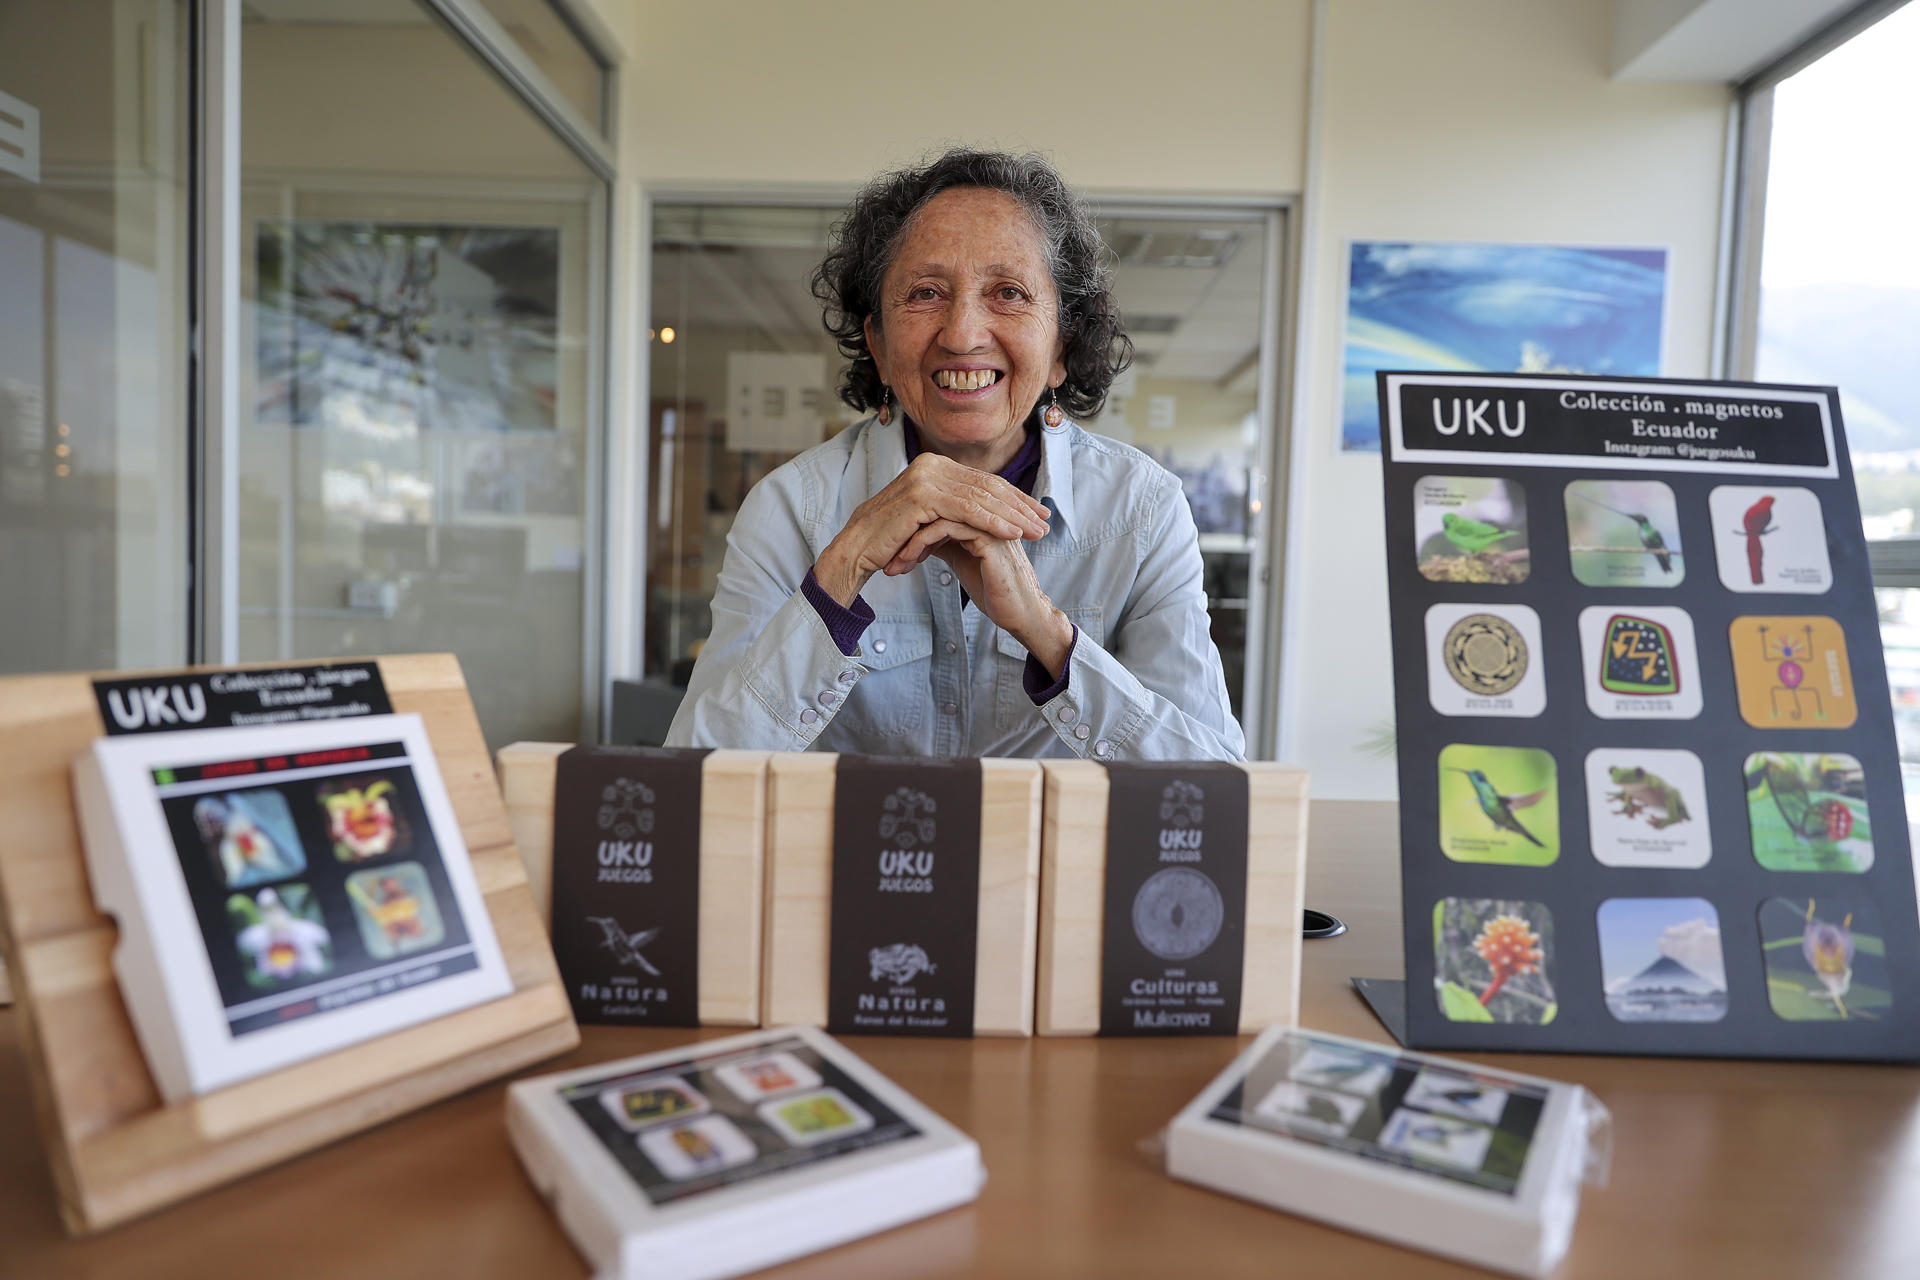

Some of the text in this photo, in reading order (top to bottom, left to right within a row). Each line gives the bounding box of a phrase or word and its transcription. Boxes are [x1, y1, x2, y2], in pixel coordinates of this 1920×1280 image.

[1559, 390, 1666, 414] Colección
[1685, 400, 1784, 421] magnetos
[1432, 396, 1526, 438] UKU
[1632, 418, 1719, 441] Ecuador
[107, 683, 208, 730] UKU
[1159, 829, 1203, 850] UKU
[598, 840, 653, 867] UKU
[879, 850, 935, 876] UKU
[1159, 850, 1202, 862] JUEGOS
[598, 868, 653, 883] JUEGOS
[878, 878, 934, 893] JUEGOS
[581, 983, 668, 1002] Natura
[1131, 978, 1219, 995] Culturas
[858, 993, 946, 1013] Natura
[1133, 1009, 1211, 1027] Mukawa
